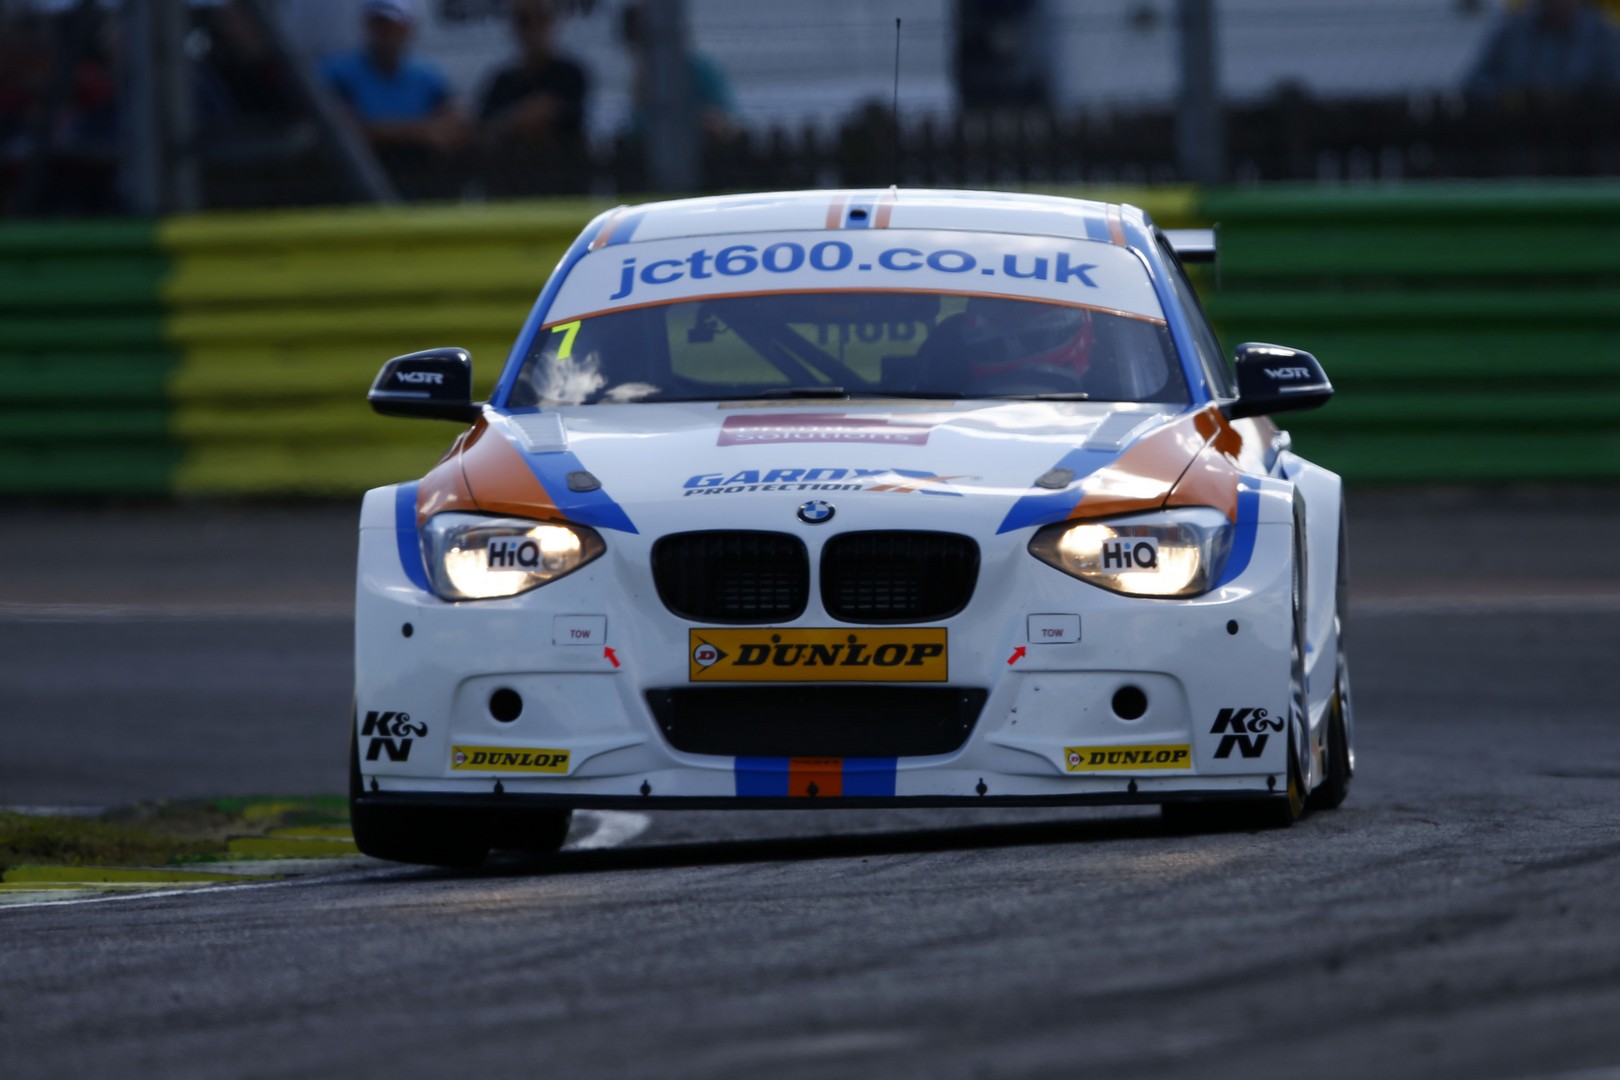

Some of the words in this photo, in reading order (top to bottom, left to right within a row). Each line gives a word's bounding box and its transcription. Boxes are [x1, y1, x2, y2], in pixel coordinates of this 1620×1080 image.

[610, 240, 1099, 301] jct600.co.uk
[552, 320, 581, 360] 7
[683, 483, 863, 497] PROTECTION
[487, 541, 539, 568] HiQ
[1103, 542, 1157, 569] HiQ
[570, 629, 591, 639] TOW
[1042, 628, 1064, 638] TOW
[732, 644, 944, 667] DUNLOP
[470, 752, 568, 766] DUNLOP
[1088, 750, 1188, 765] DUNLOP
